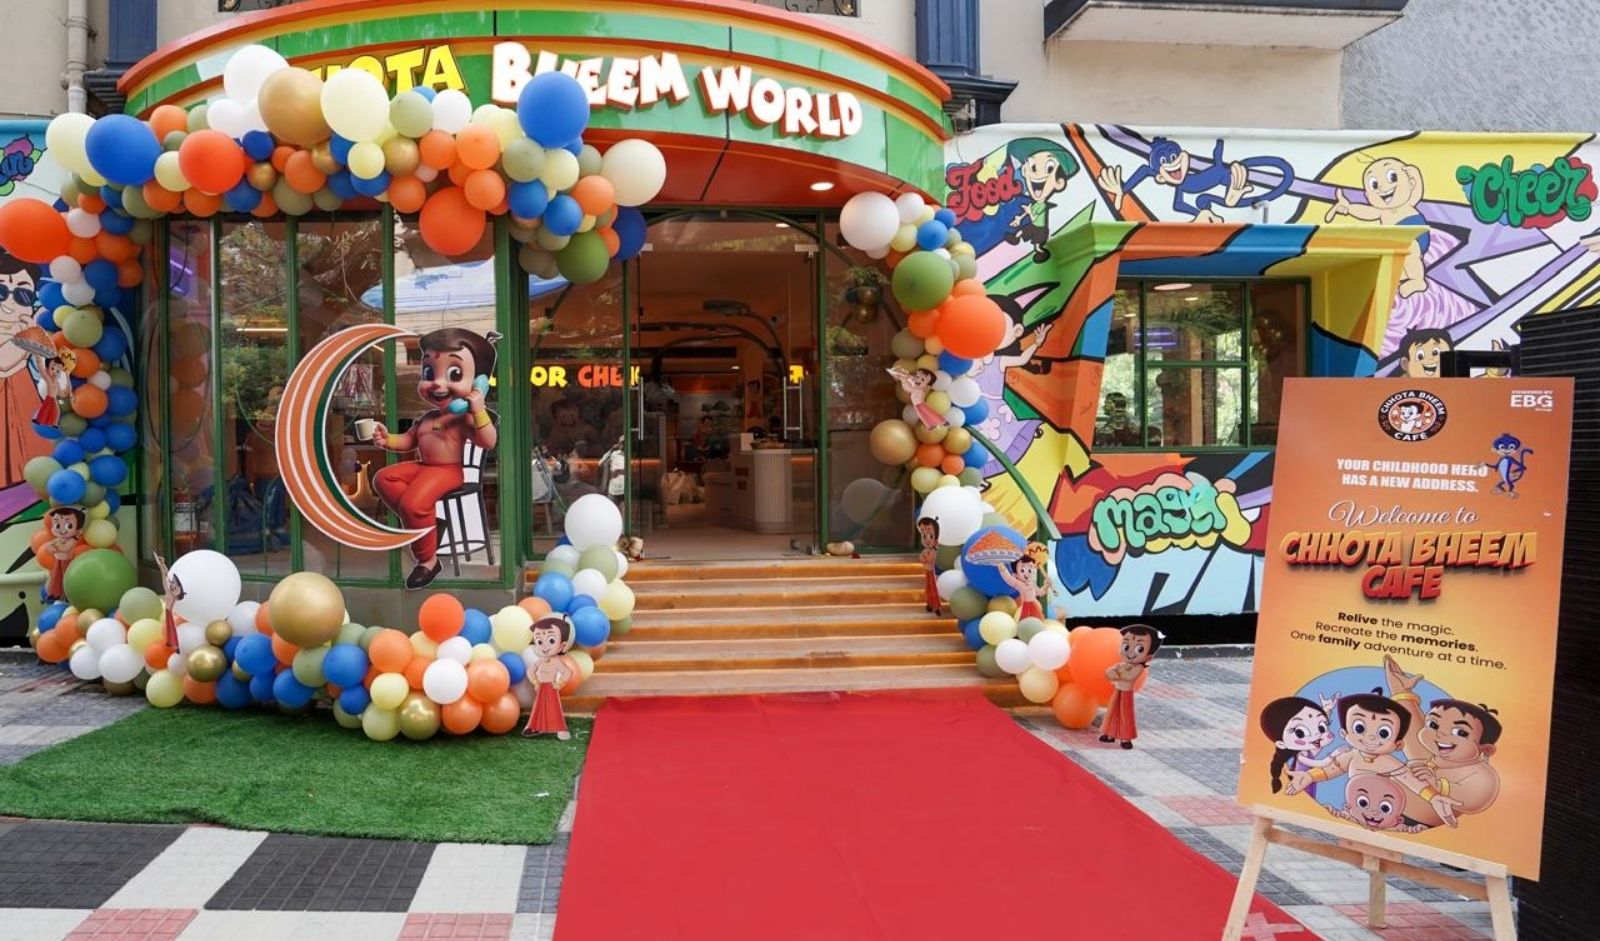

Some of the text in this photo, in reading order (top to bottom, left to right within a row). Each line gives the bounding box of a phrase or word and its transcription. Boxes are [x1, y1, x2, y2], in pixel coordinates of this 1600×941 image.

[698, 65, 863, 138] WORLD
[1456, 155, 1592, 228] Cheer
[1381, 391, 1446, 415] CHHOTA BHEEM
[1510, 394, 1553, 408] EBG
[1394, 432, 1428, 441] CAFE
[1337, 458, 1370, 471] YOUR
[1372, 460, 1448, 475] CHILDHOOD
[1342, 474, 1480, 493] HAS A NEW ADDRESS.
[1328, 500, 1478, 528] Welcome to
[1279, 530, 1538, 569] CHHOTA BHEEM
[1361, 564, 1445, 600] CAFE
[1315, 620, 1479, 652] Recreate the memories.
[1338, 612, 1455, 637] Relive the magic.
[1290, 630, 1508, 671] One family adventure at a time.
